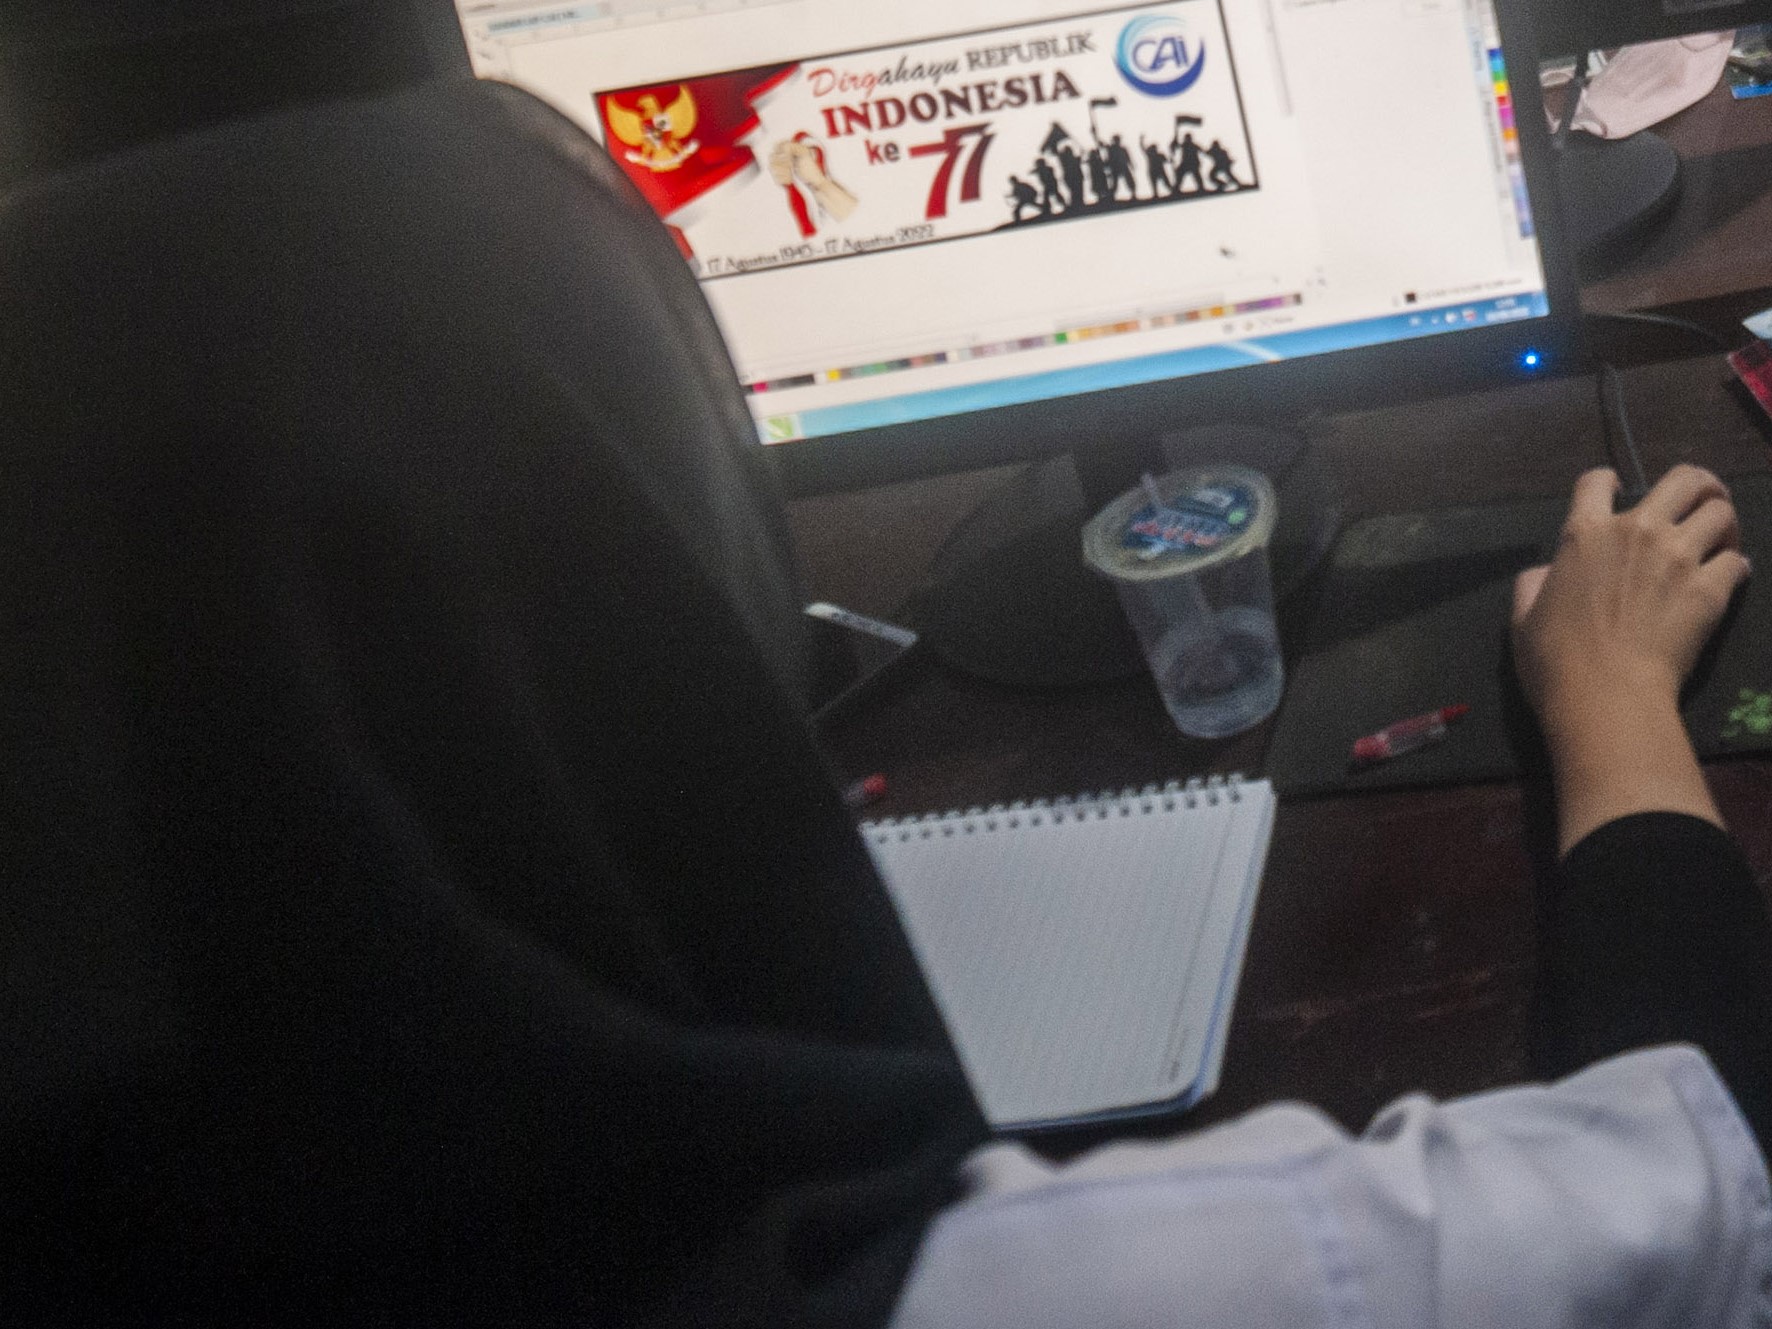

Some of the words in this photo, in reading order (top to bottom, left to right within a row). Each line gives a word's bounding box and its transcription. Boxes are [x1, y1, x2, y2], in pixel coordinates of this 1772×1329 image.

[806, 55, 960, 100] Dirgahayu
[966, 33, 1099, 72] REPUBLIK
[821, 71, 1081, 140] INDONESIA
[867, 139, 900, 167] ke
[908, 121, 999, 222] 77
[725, 251, 779, 274] Agustus
[840, 235, 895, 255] Agustus
[899, 223, 935, 241] 2022
